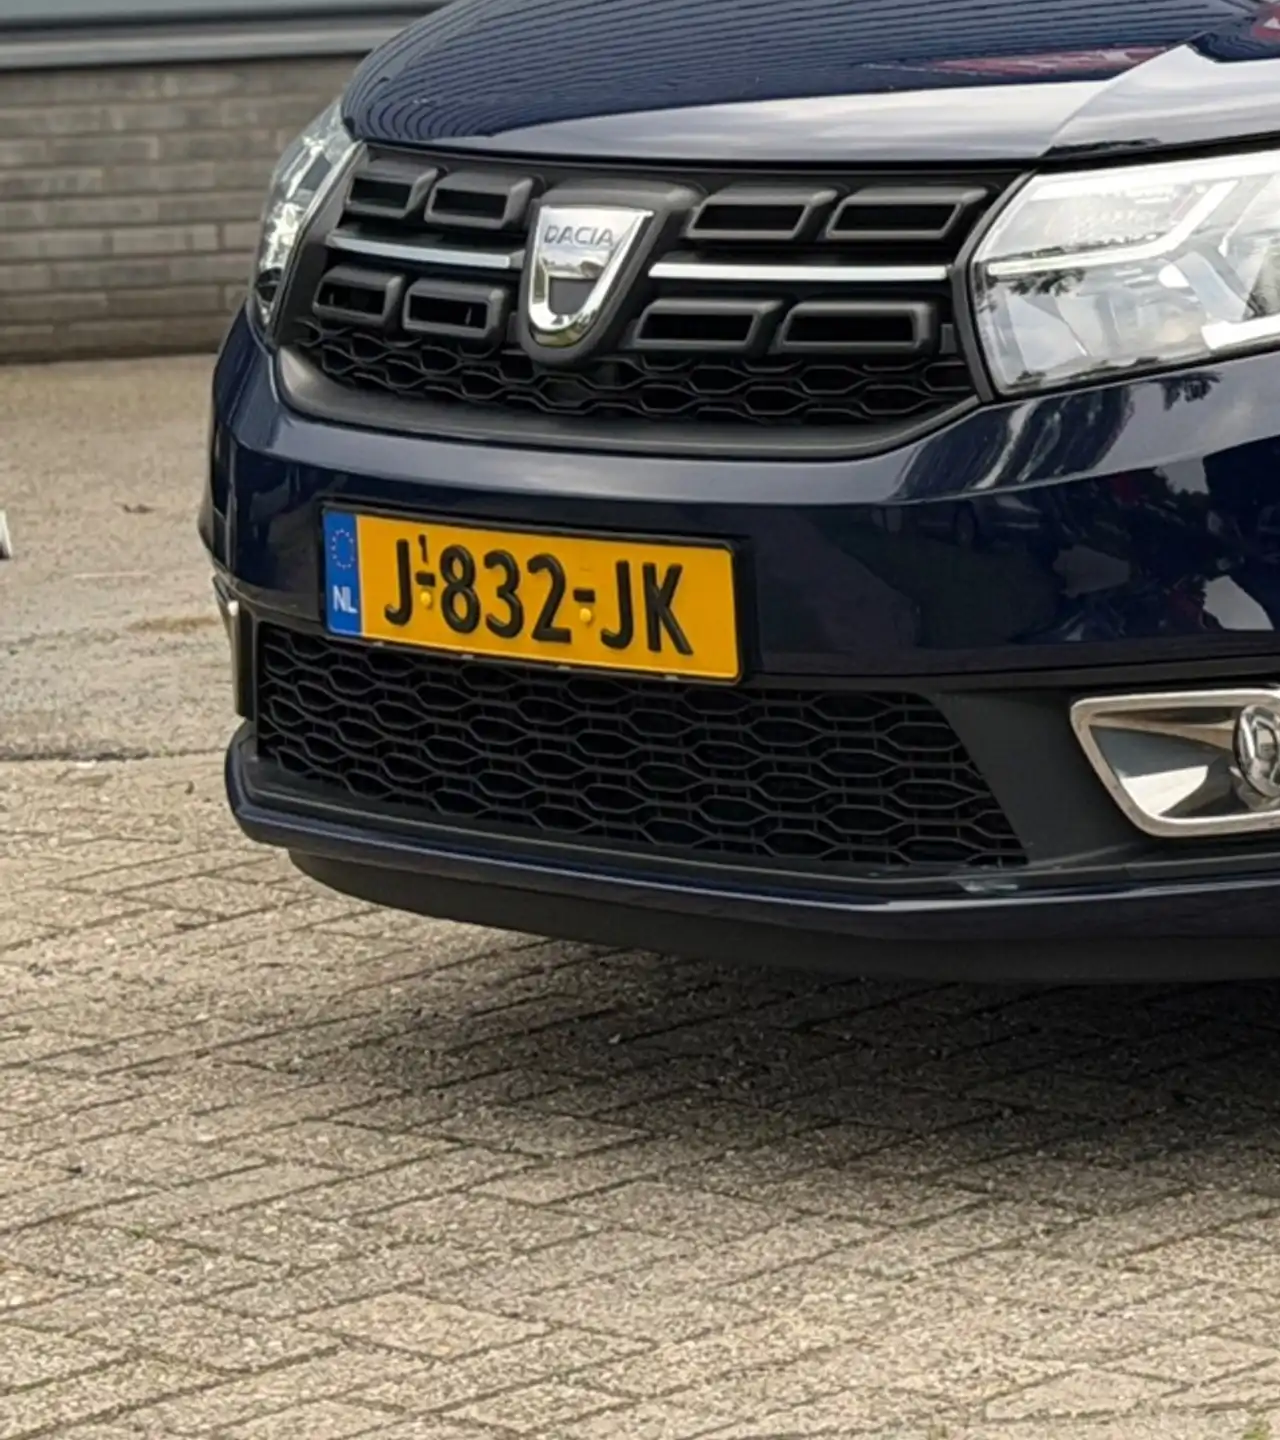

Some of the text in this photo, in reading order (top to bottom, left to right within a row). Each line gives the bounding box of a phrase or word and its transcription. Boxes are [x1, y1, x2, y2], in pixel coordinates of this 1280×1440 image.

[544, 225, 614, 246] DACIA
[332, 538, 694, 656] NL J-832-JK
